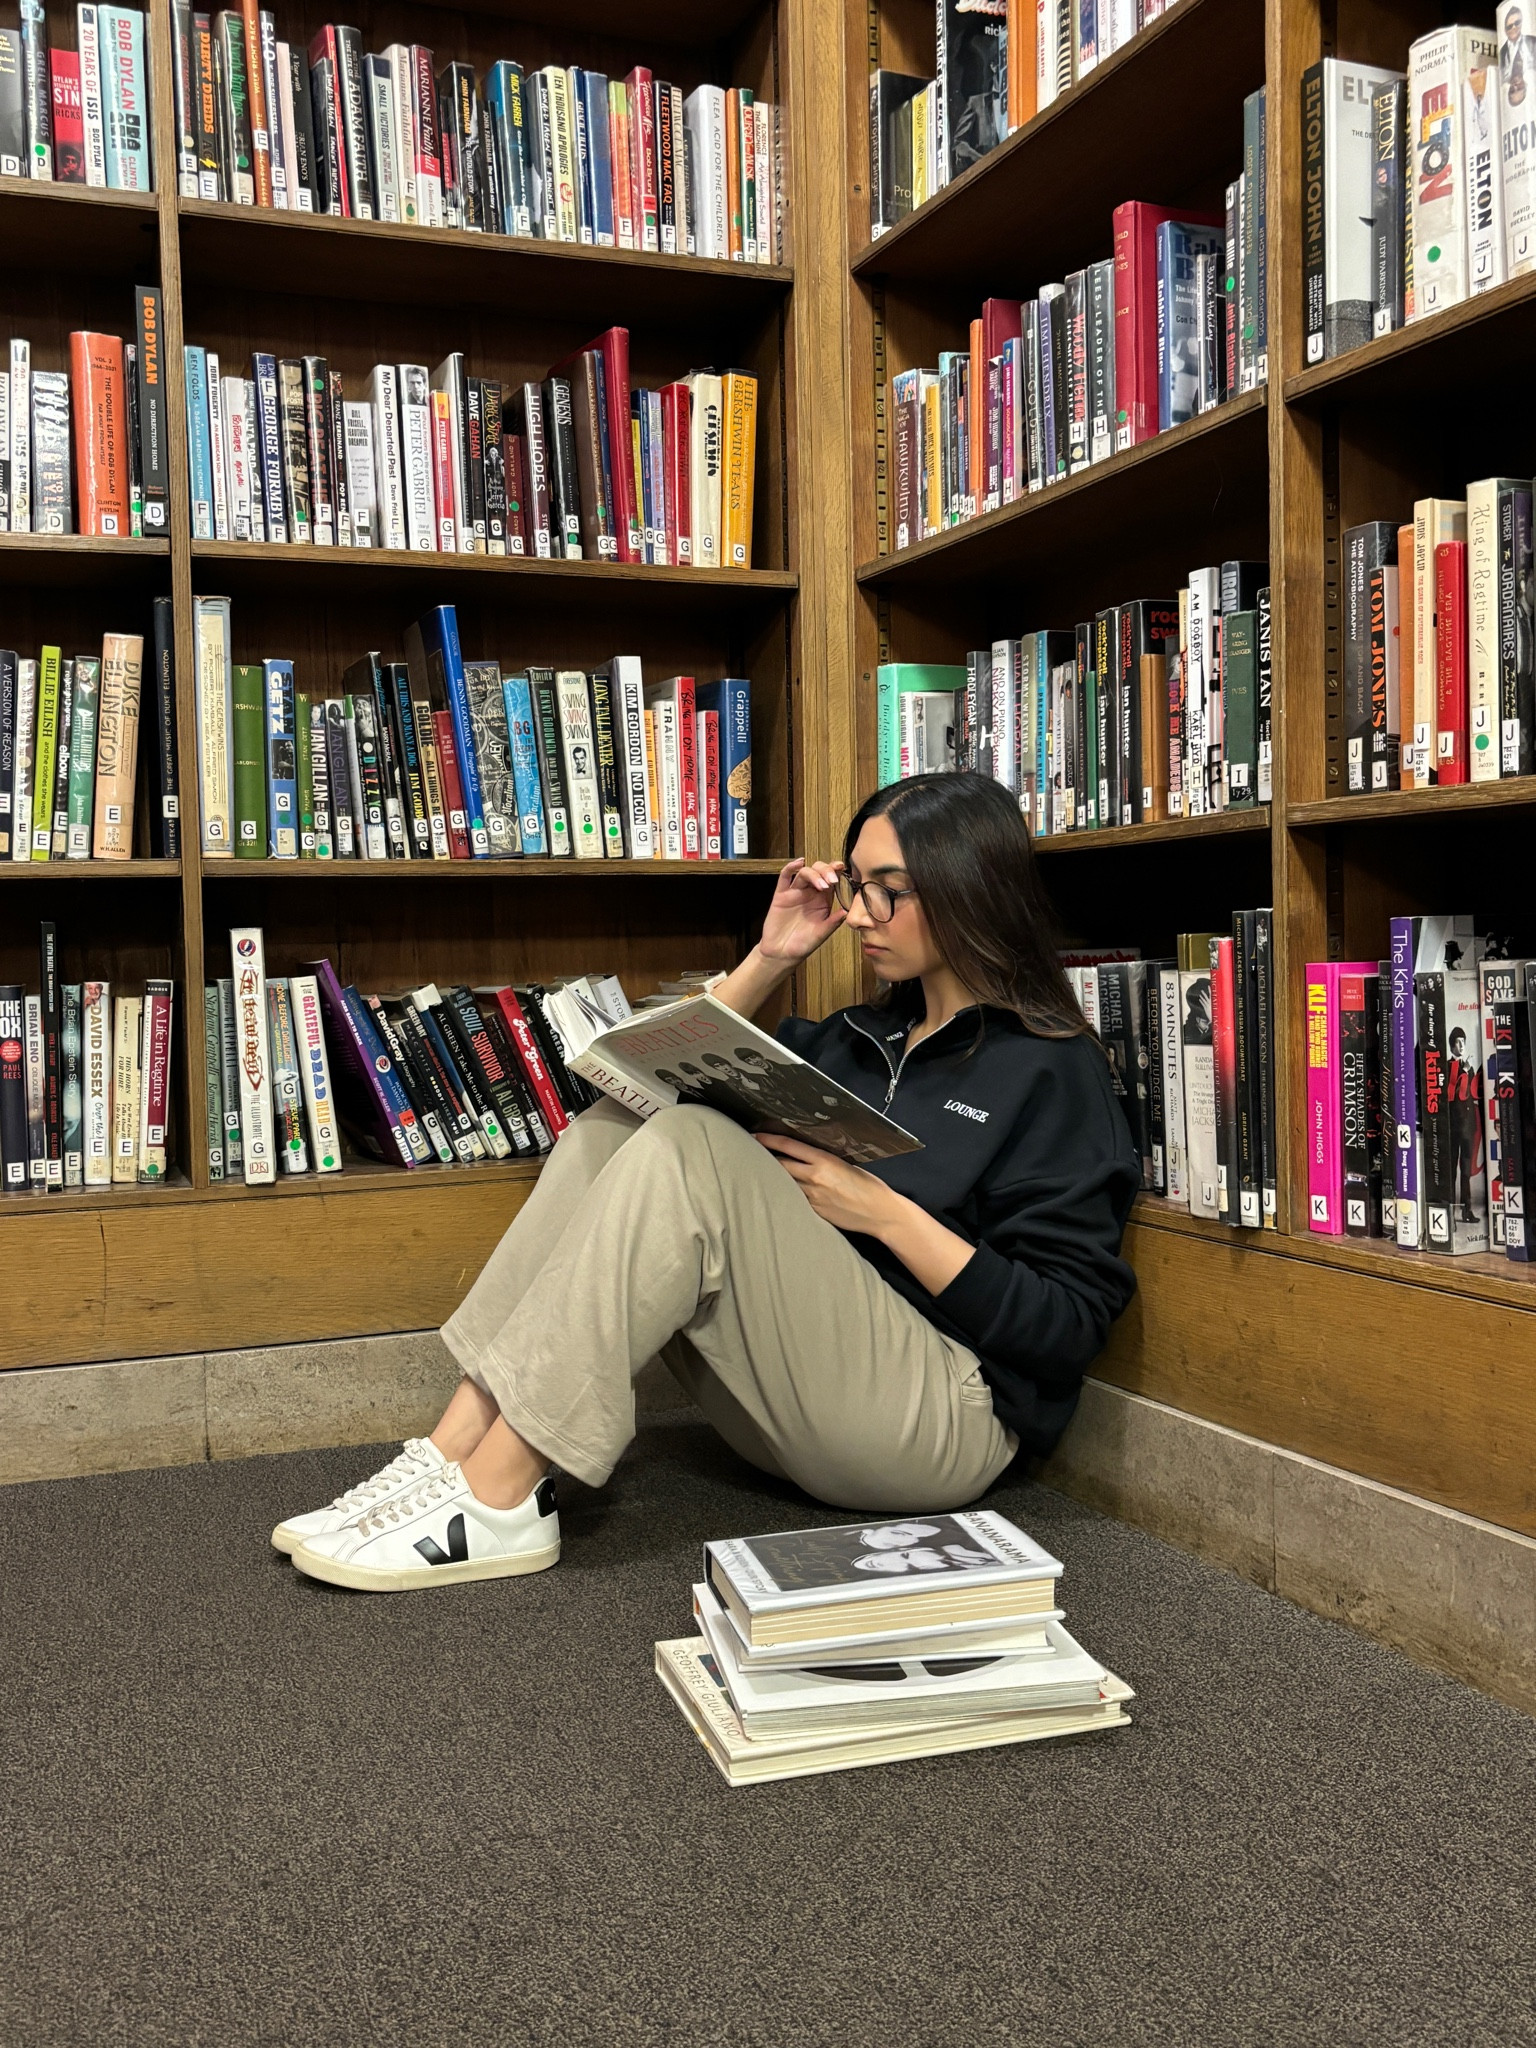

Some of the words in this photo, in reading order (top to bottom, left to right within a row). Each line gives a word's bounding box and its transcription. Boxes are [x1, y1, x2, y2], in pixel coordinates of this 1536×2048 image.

[83, 29, 94, 41] 20
[118, 19, 132, 51] BOB
[262, 21, 276, 62] EXO
[84, 45, 96, 75] YEARS
[200, 32, 212, 78] DIRTY
[1415, 53, 1455, 77] NORMAN
[1419, 44, 1449, 63] PHILIP
[54, 89, 81, 107] SIN
[86, 80, 97, 93] OF
[120, 56, 136, 111] DYLAN
[554, 75, 563, 90] TEN
[55, 109, 81, 120] RICKS
[87, 97, 98, 120] ISIS
[202, 82, 214, 134] DEEDS
[350, 81, 364, 132] ADAM
[555, 91, 566, 127] THOUSAND
[1306, 76, 1322, 162] ELTON
[92, 128, 100, 143] BOB
[661, 96, 671, 157] FLEETWOOD
[1378, 92, 1397, 163] ELTON
[1417, 82, 1454, 204] ELTON
[93, 145, 102, 168] DYLAN
[352, 135, 368, 182] FAITH
[558, 129, 568, 176] APOLOGIES
[662, 160, 672, 182] MAC
[663, 184, 673, 204] FAQ
[1307, 166, 1322, 243] JOHN
[1476, 150, 1492, 231] ELTON
[716, 196, 724, 241] CHILDREN
[1478, 255, 1487, 273] J
[143, 296, 156, 329] BOB
[144, 333, 158, 385] DYLAN
[190, 354, 198, 371] BEN
[191, 375, 200, 400] FOLDS
[382, 371, 390, 386] My
[743, 379, 753, 412] THE
[150, 399, 156, 410] NO
[383, 388, 391, 411] Dear
[468, 391, 479, 420] DAVE
[529, 395, 541, 436] HIGH
[731, 379, 744, 456] GERSHWIN
[264, 396, 278, 456] GEORGE
[385, 413, 395, 457] Departed
[409, 410, 422, 456] PETER
[469, 421, 481, 459] GAHAN
[108, 441, 114, 449] OF
[388, 459, 396, 478] Past
[531, 438, 545, 492] HOPES
[267, 460, 284, 522] FORMBY
[412, 457, 426, 520] GABRIEL
[730, 459, 743, 510] YEARS
[1222, 571, 1237, 611] IRON
[1370, 570, 1384, 633] TOM
[1502, 563, 1515, 660] JORDANAIRES
[1259, 599, 1271, 663] JANIS
[45, 657, 56, 696] BILLIE
[121, 661, 140, 718] DUKE
[457, 679, 466, 703] BENNY
[1260, 669, 1272, 708] IAN
[1371, 639, 1386, 728] JONES
[3, 674, 12, 716] VERSION
[270, 671, 283, 735] GETZ
[281, 672, 294, 734] STAN
[562, 694, 586, 709] SWING
[625, 684, 638, 708] KIM
[999, 691, 1006, 707] ON
[3, 718, 11, 730] OF
[42, 699, 54, 737] EILISH
[98, 658, 121, 777] ELLINGTON
[416, 705, 431, 746] GOLDIE
[460, 705, 472, 746] GOODMAN
[564, 709, 588, 724] SWING
[565, 724, 589, 739] SWING
[736, 690, 747, 743] Grappelli
[3, 733, 12, 771] REASON
[627, 710, 642, 766] GORDON
[59, 745, 70, 780] elbow
[631, 772, 644, 792] NO
[633, 794, 646, 826] ICON
[638, 831, 648, 842] G
[1393, 930, 1408, 965] The
[1166, 982, 1175, 999] 83
[1308, 983, 1327, 1015] KLF
[1394, 968, 1409, 1009] Kinks
[1485, 988, 1514, 1001] SAVE
[1487, 976, 1511, 990] GOD
[0, 1000, 20, 1017] THE
[27, 1002, 38, 1037] BRIAN
[156, 1005, 167, 1016] A
[1108, 974, 1123, 1032] MICHAEL
[1495, 1014, 1511, 1026] THE
[0, 1018, 21, 1038] OX
[67, 1009, 75, 1034] Brian
[90, 1004, 102, 1049] DAVID
[156, 1018, 167, 1040] Life
[303, 996, 320, 1047] GRATEFUL
[622, 1014, 719, 1054] BEATLES
[29, 1039, 39, 1063] ENO
[68, 1036, 76, 1072] Epstein
[156, 1041, 166, 1054] in
[460, 1006, 484, 1034] SOUL
[472, 1031, 504, 1083] SURVIVOR
[513, 1018, 530, 1048] Peter
[525, 1047, 544, 1080] Green
[1151, 1036, 1159, 1060] YOU
[1166, 1004, 1178, 1080] MINUTES
[2, 1064, 21, 1072] PAUL
[3, 1072, 22, 1080] REES
[90, 1053, 103, 1098] ESSEX
[151, 1056, 166, 1106] Ragtime
[311, 1049, 327, 1099] DEAD
[581, 1061, 596, 1073] THE
[1152, 1061, 1161, 1101] JUDGE
[1425, 1051, 1439, 1114] kinks
[67, 1073, 77, 1098] Story
[1343, 1052, 1357, 1149] CRIMSON
[943, 1099, 990, 1123] LOUNGE
[1154, 1105, 1162, 1122] ME
[1315, 1100, 1323, 1129] JOHN
[1316, 1132, 1324, 1164] HIGGS
[1432, 1213, 1443, 1230] K
[962, 1512, 1032, 1566] BANANARAMA
[672, 1649, 711, 1691] GEOFFREY
[700, 1693, 741, 1738] GIULIANO
